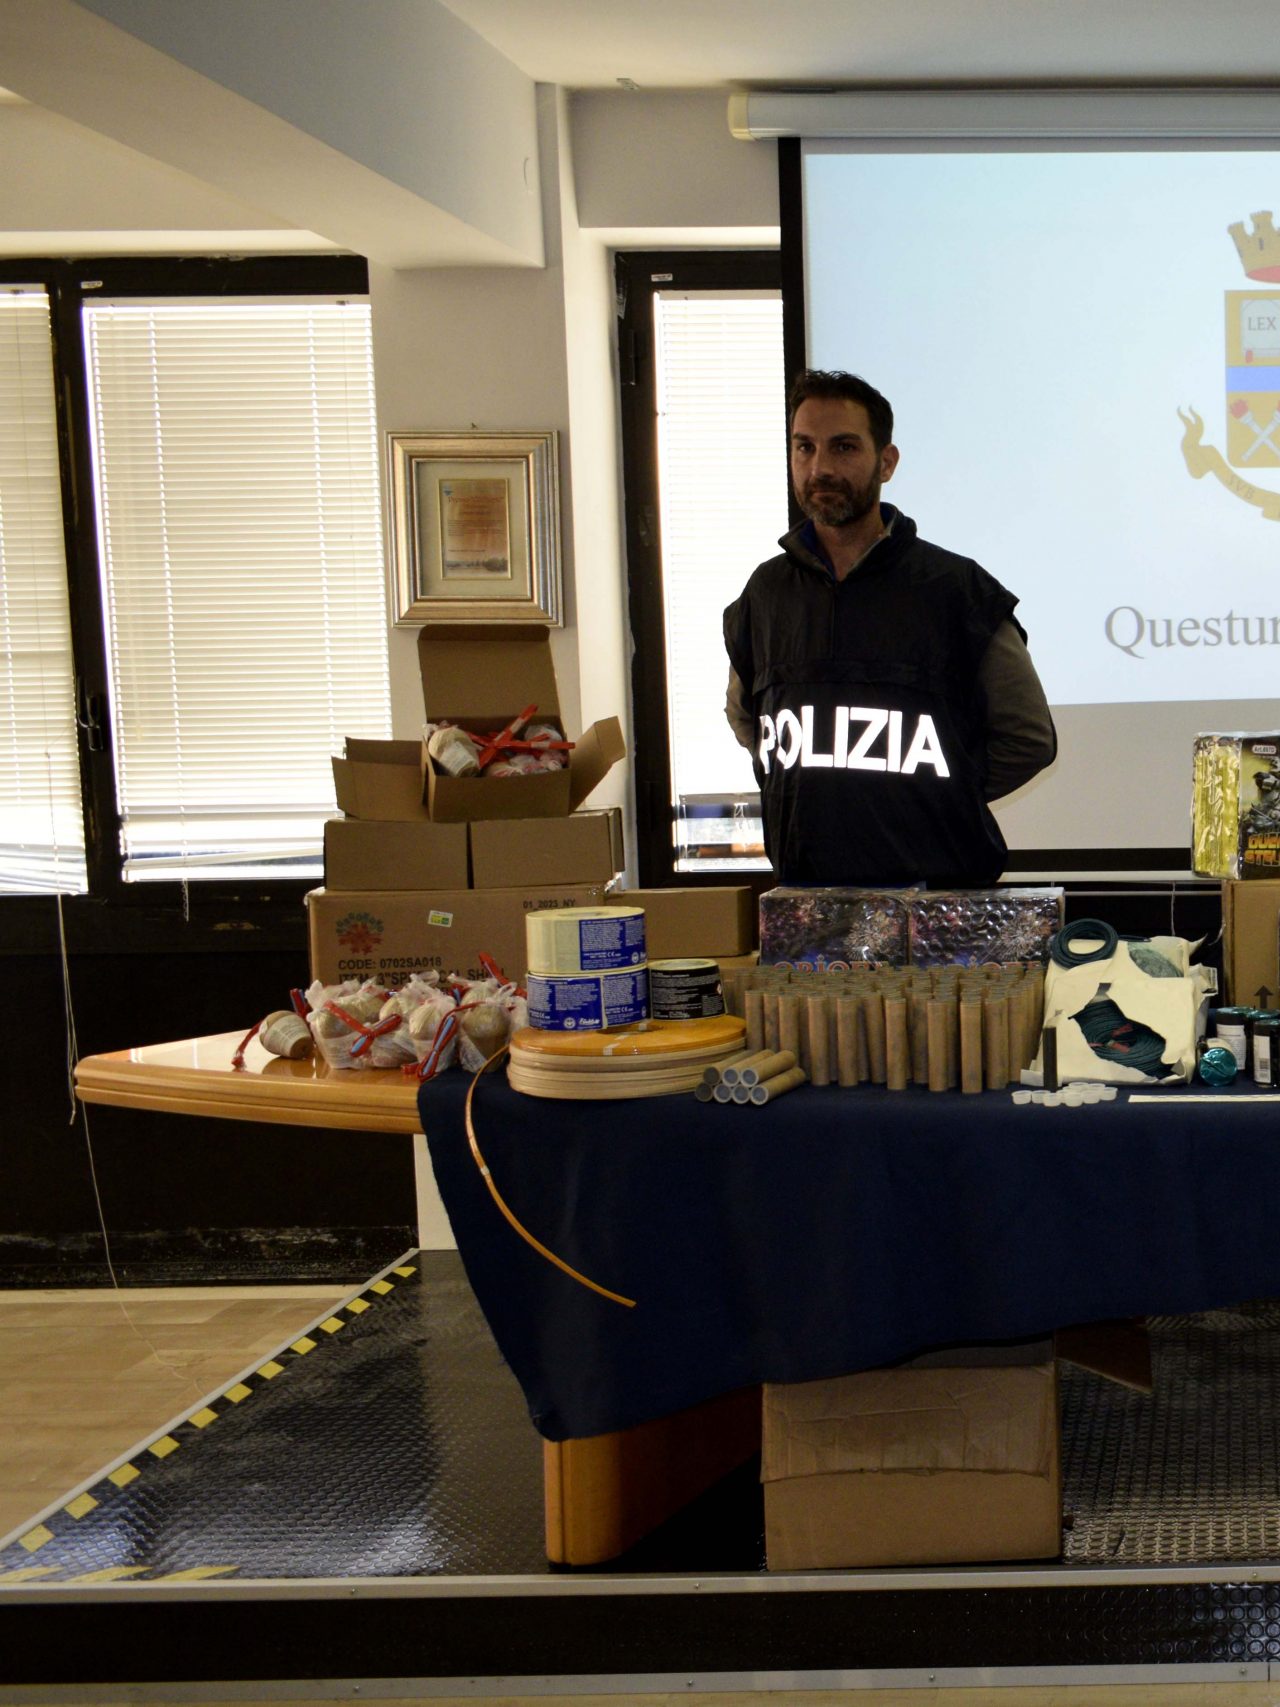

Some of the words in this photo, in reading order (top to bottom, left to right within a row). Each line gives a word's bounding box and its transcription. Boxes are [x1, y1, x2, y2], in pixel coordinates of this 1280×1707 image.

[1248, 316, 1277, 332] LEX
[759, 705, 951, 778] POLIZIA
[338, 959, 376, 970] CODE:
